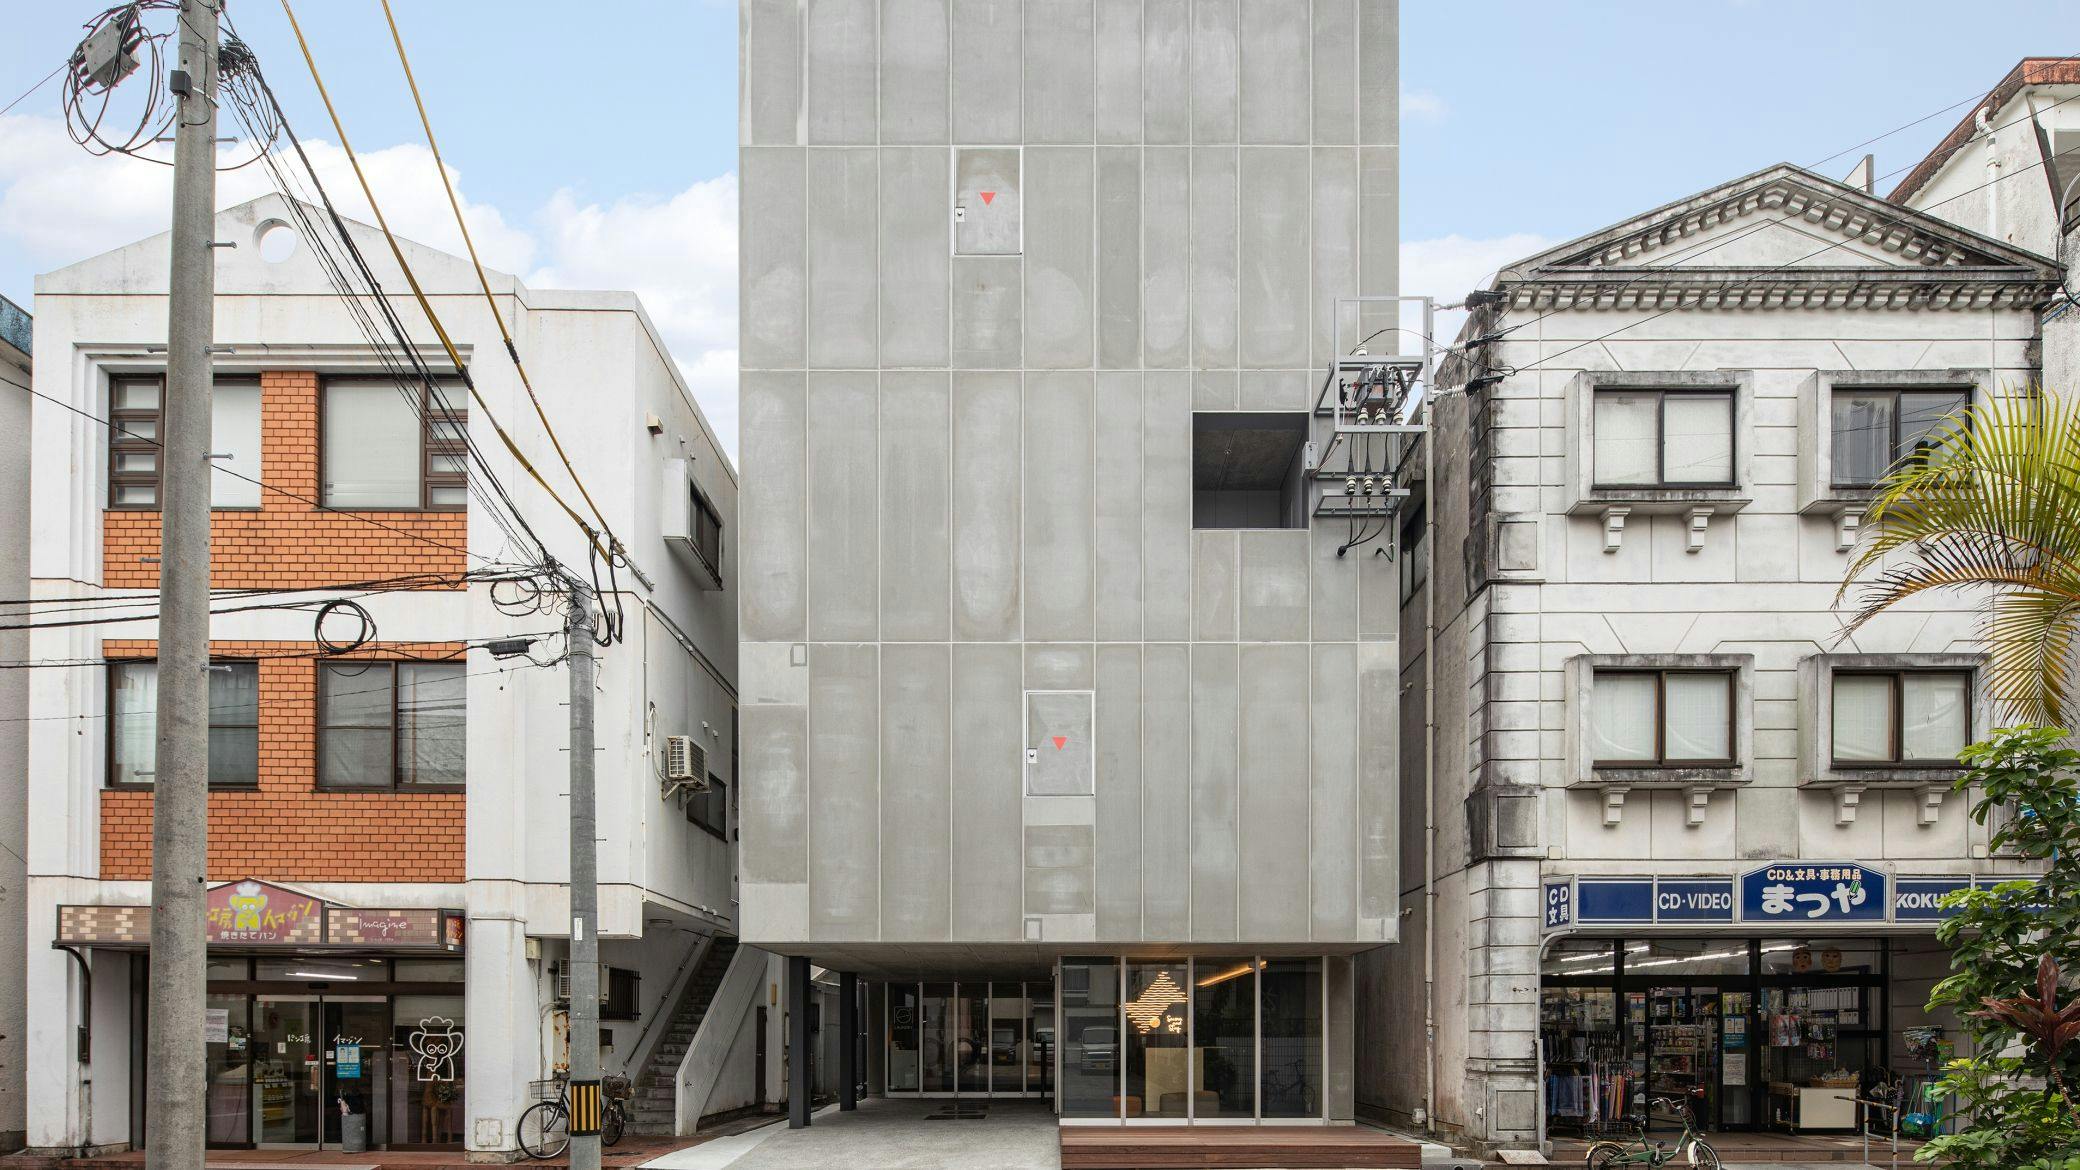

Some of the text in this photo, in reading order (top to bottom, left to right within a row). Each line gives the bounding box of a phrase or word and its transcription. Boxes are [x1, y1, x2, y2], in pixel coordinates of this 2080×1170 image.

[1761, 883, 1867, 918] まつや
[263, 900, 313, 930] イマジン
[1549, 904, 1568, 925] 文具
[220, 931, 277, 940] 焼きたてパン
